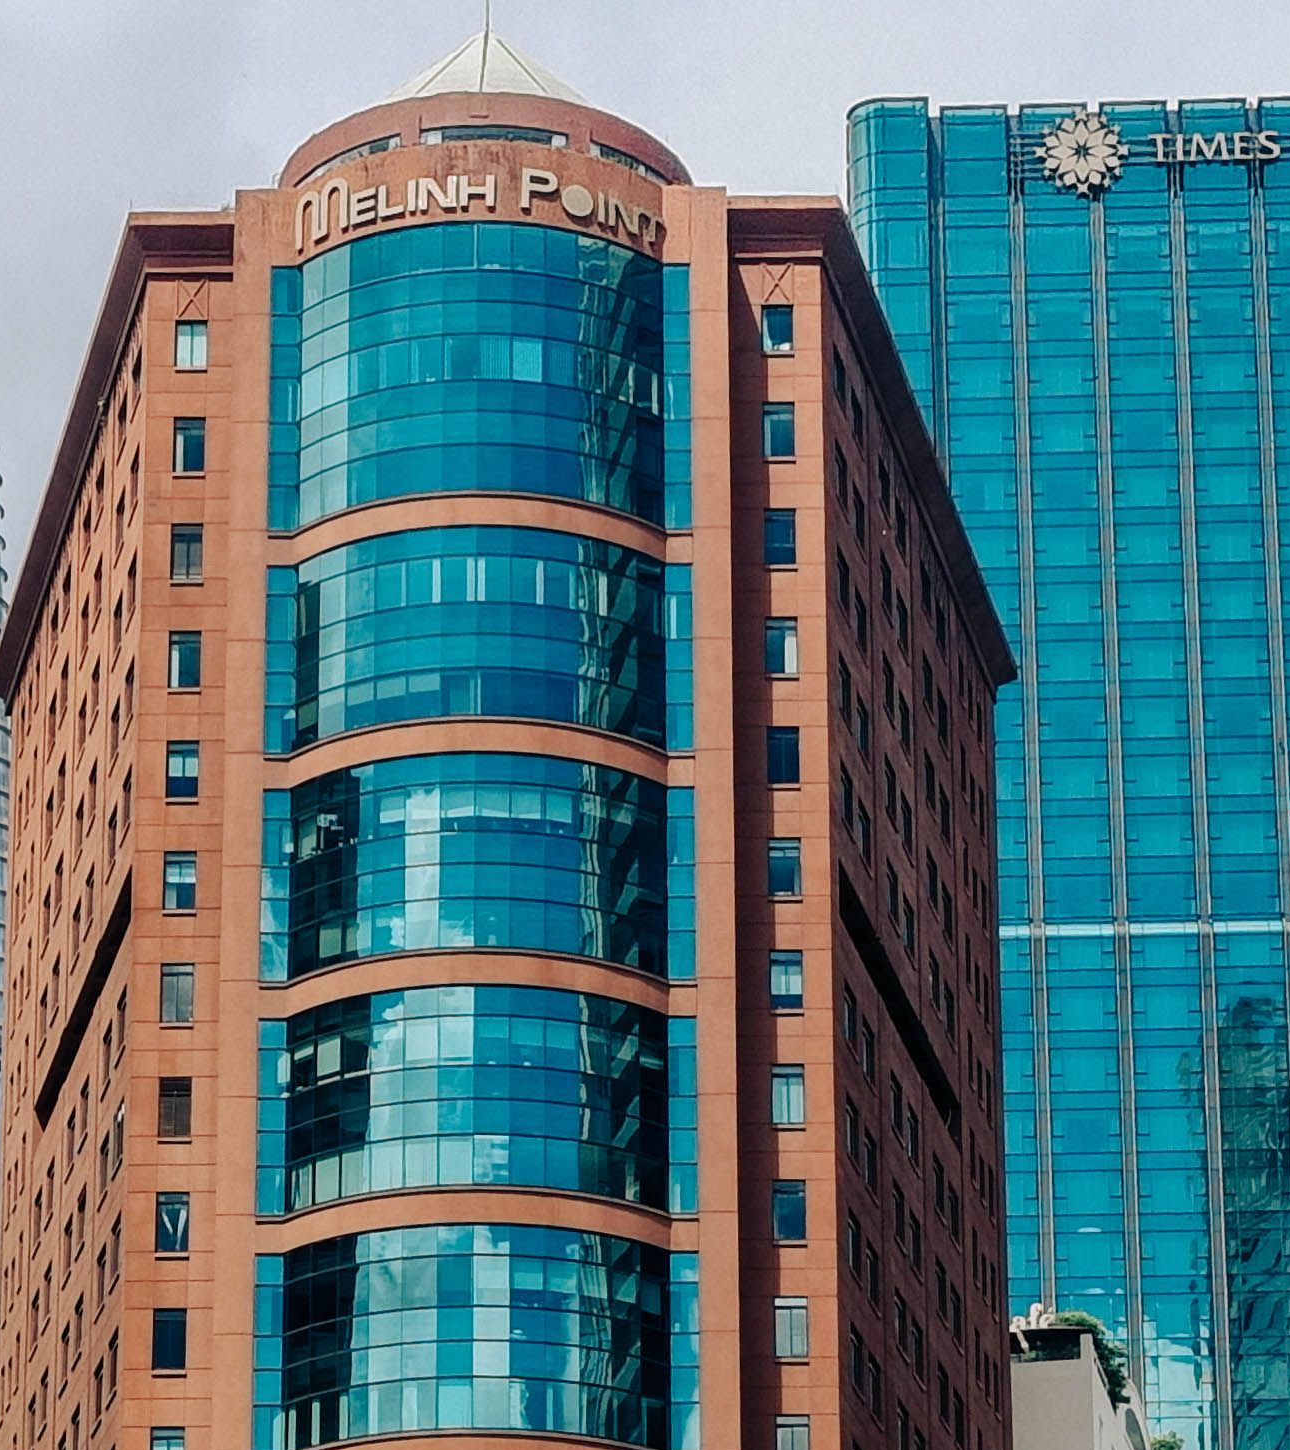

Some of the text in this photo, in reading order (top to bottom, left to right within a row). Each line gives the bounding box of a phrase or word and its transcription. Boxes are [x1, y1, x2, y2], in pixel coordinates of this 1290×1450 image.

[1148, 131, 1281, 163] TIMES
[295, 167, 663, 252] MELINH POINT
